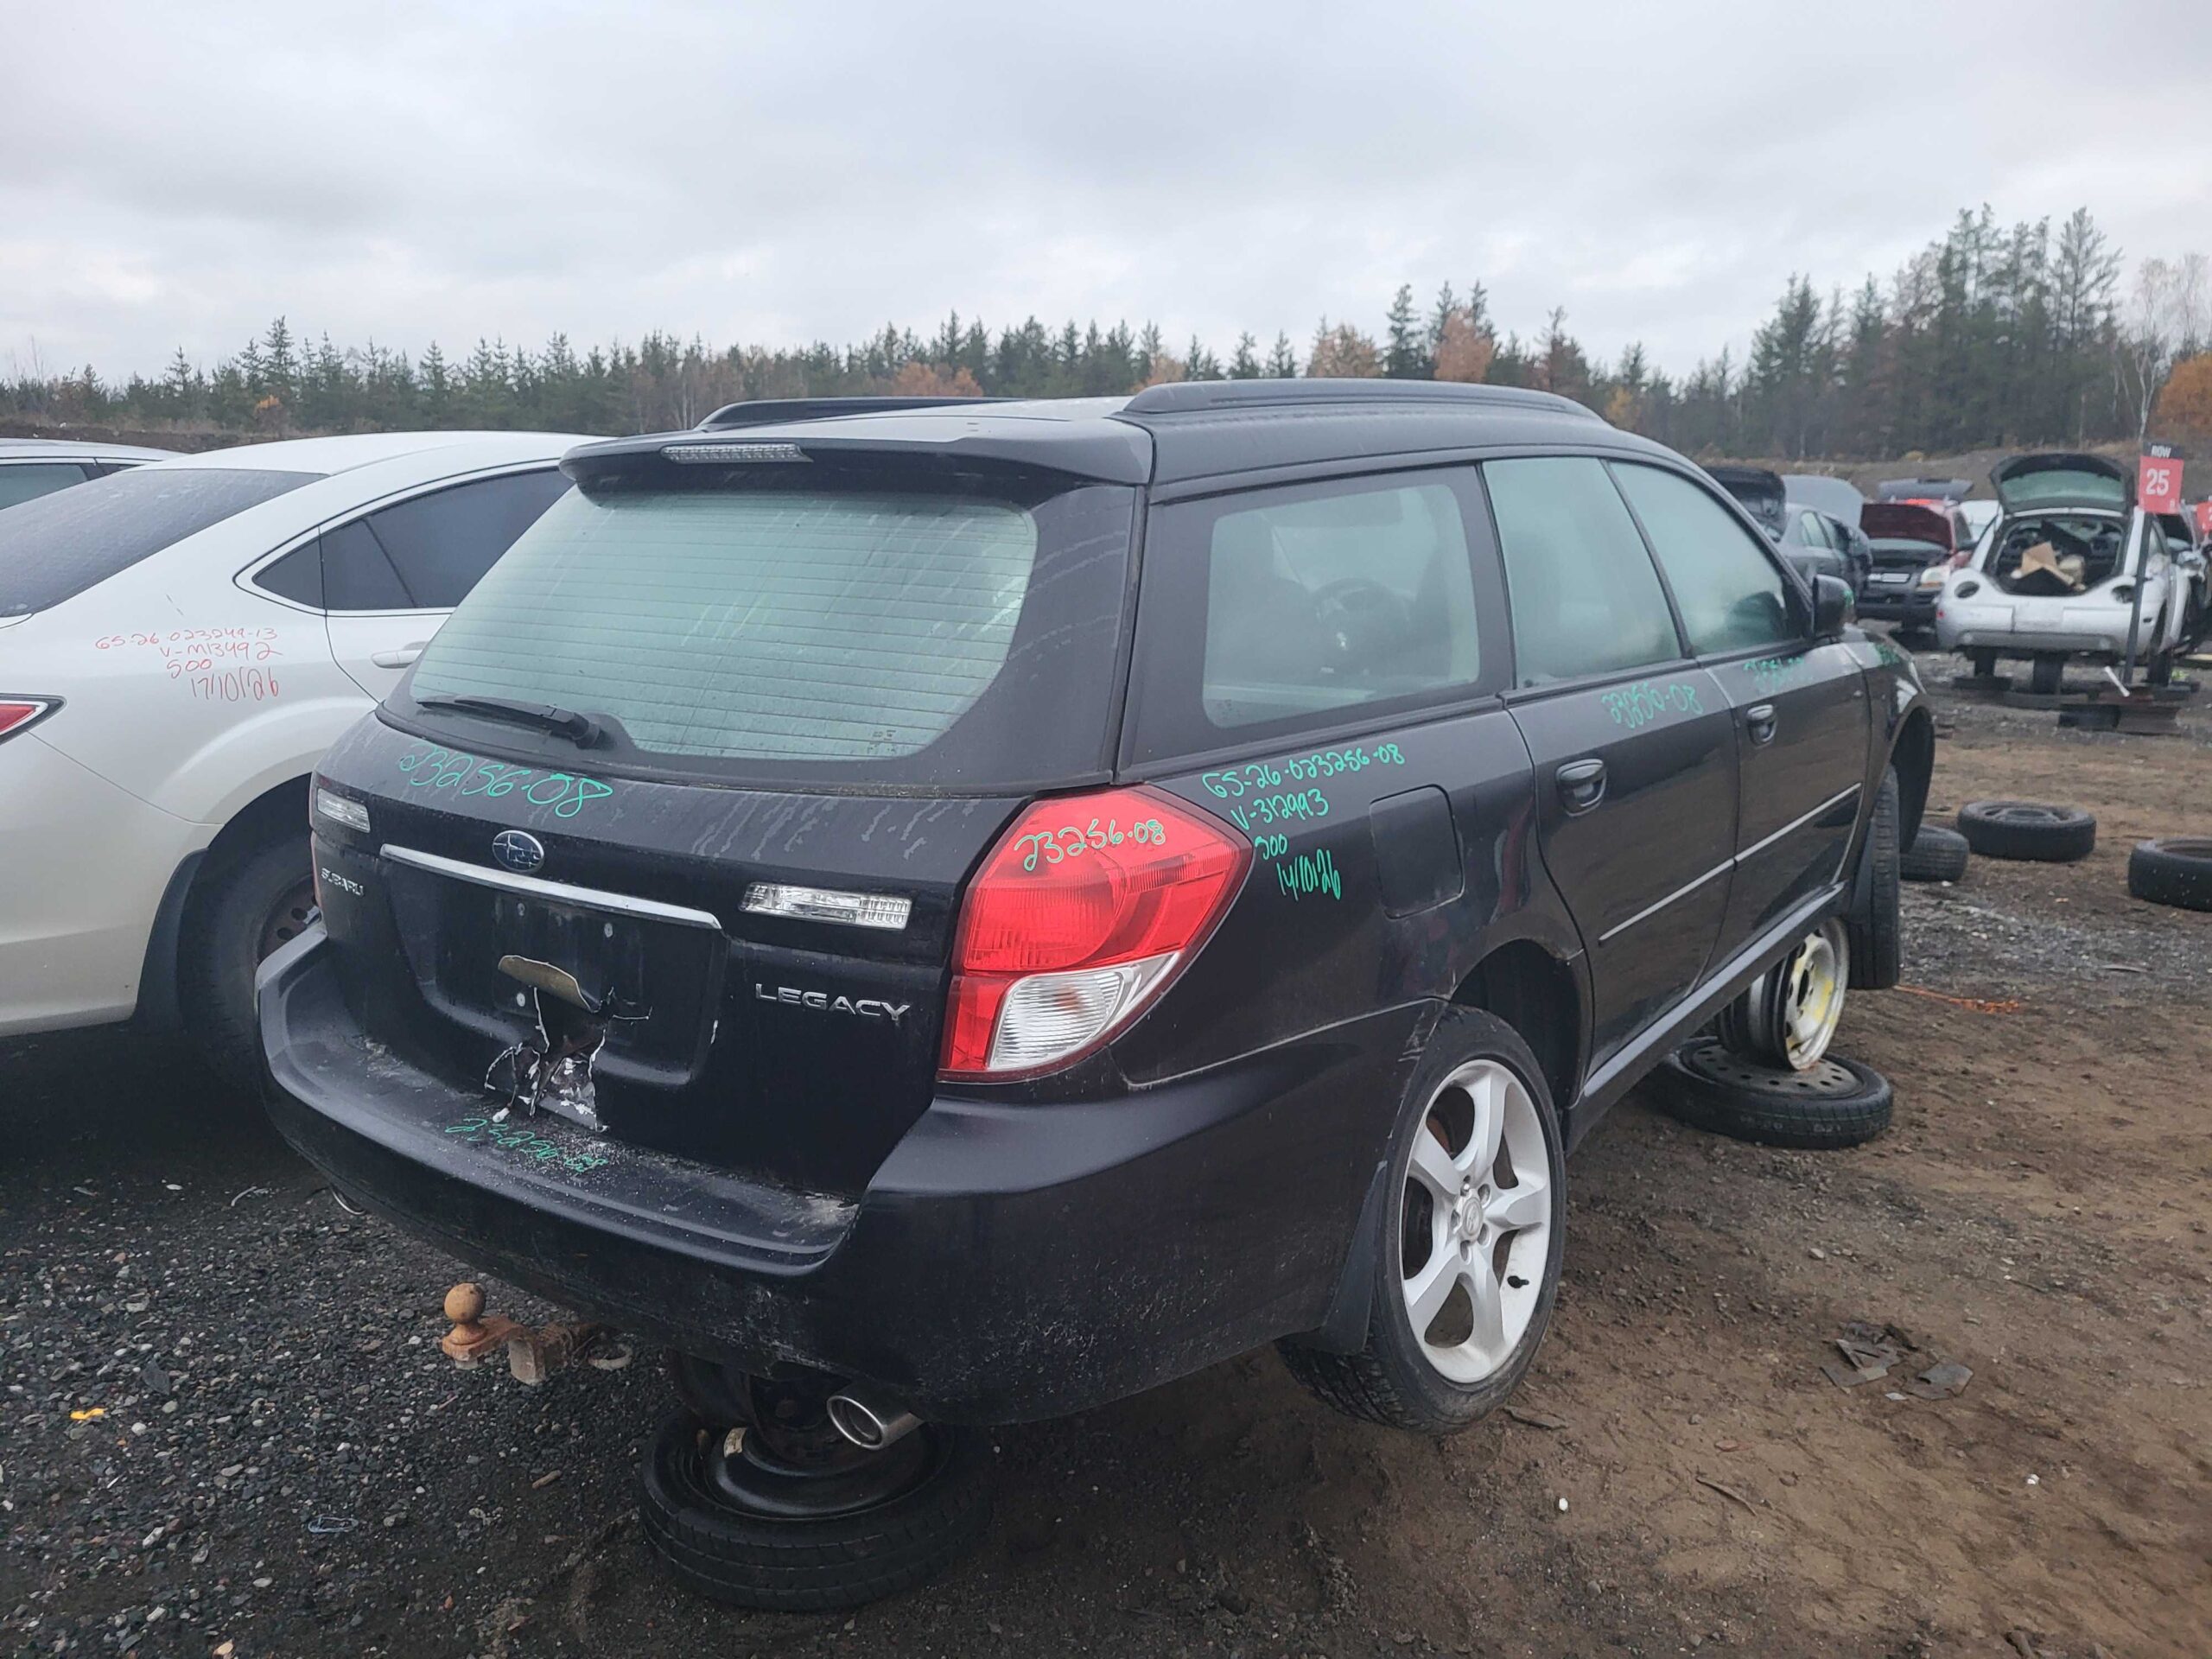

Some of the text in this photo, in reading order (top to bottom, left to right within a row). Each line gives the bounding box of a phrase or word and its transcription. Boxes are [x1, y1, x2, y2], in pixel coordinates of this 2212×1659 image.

[2152, 445, 2171, 458] ROW
[2145, 467, 2171, 496] 25
[166, 658, 213, 679] 500
[755, 982, 911, 1021] LEGACY
